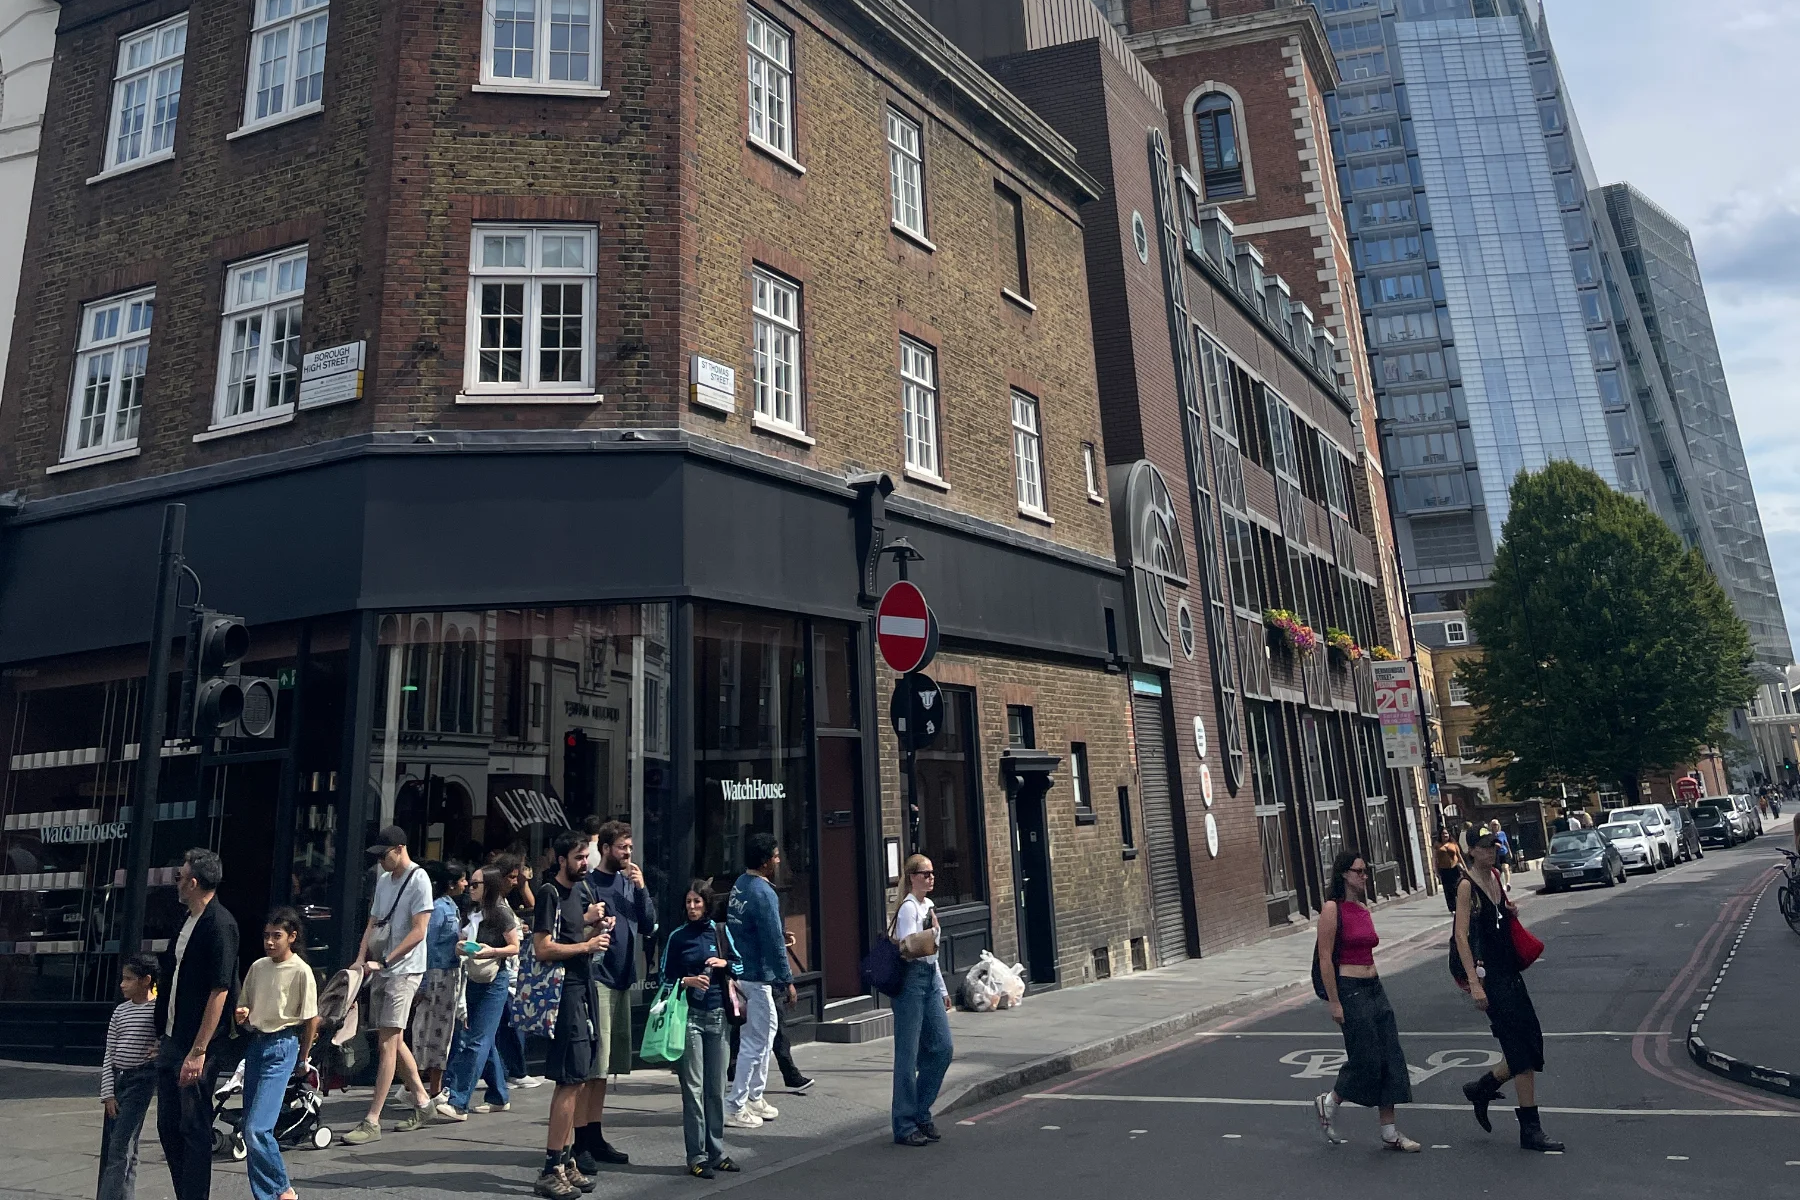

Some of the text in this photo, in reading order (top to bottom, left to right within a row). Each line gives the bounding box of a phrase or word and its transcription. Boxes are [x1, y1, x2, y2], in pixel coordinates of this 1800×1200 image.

[314, 347, 350, 362] BOROUGH
[303, 362, 321, 374] HIGH
[323, 356, 349, 369] STREET
[708, 362, 729, 378] THOMAS
[711, 372, 729, 385] STREET
[1375, 666, 1405, 675] BERMONDSEY
[1375, 688, 1413, 713] 20
[720, 777, 786, 801] WatchHouse.
[40, 821, 128, 844] WatchHouse.
